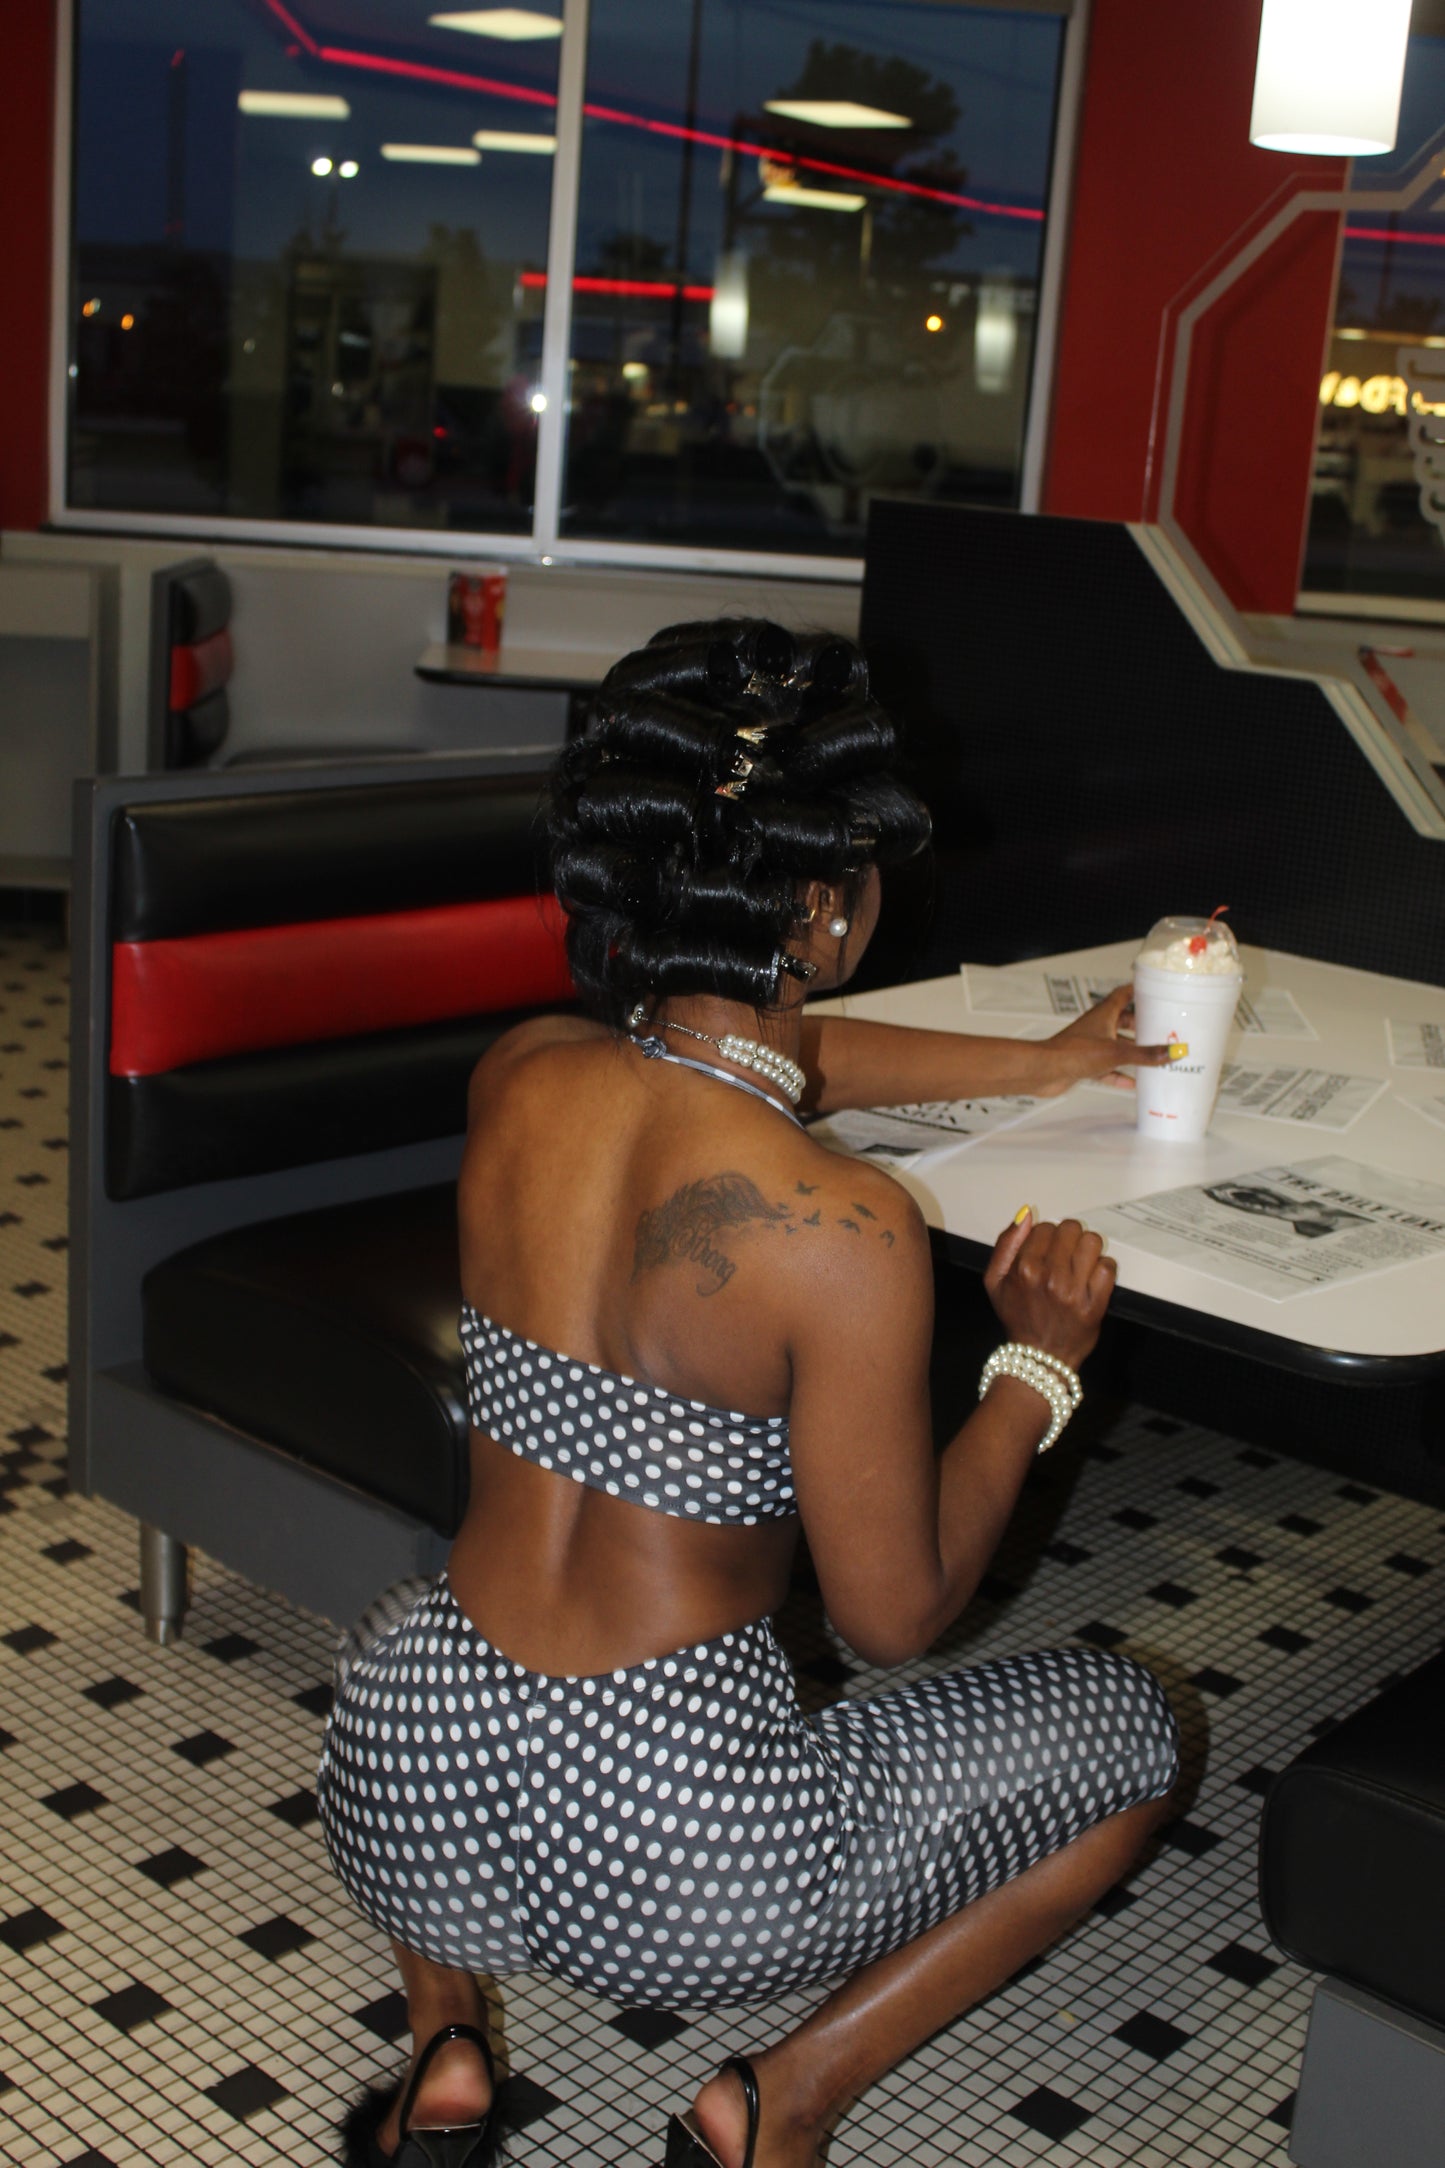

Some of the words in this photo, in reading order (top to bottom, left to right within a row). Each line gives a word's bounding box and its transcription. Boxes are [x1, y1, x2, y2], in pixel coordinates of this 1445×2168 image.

[1279, 1173, 1319, 1191] THE
[1321, 1189, 1385, 1213] DAILY
[1389, 1211, 1445, 1233] LUXE
